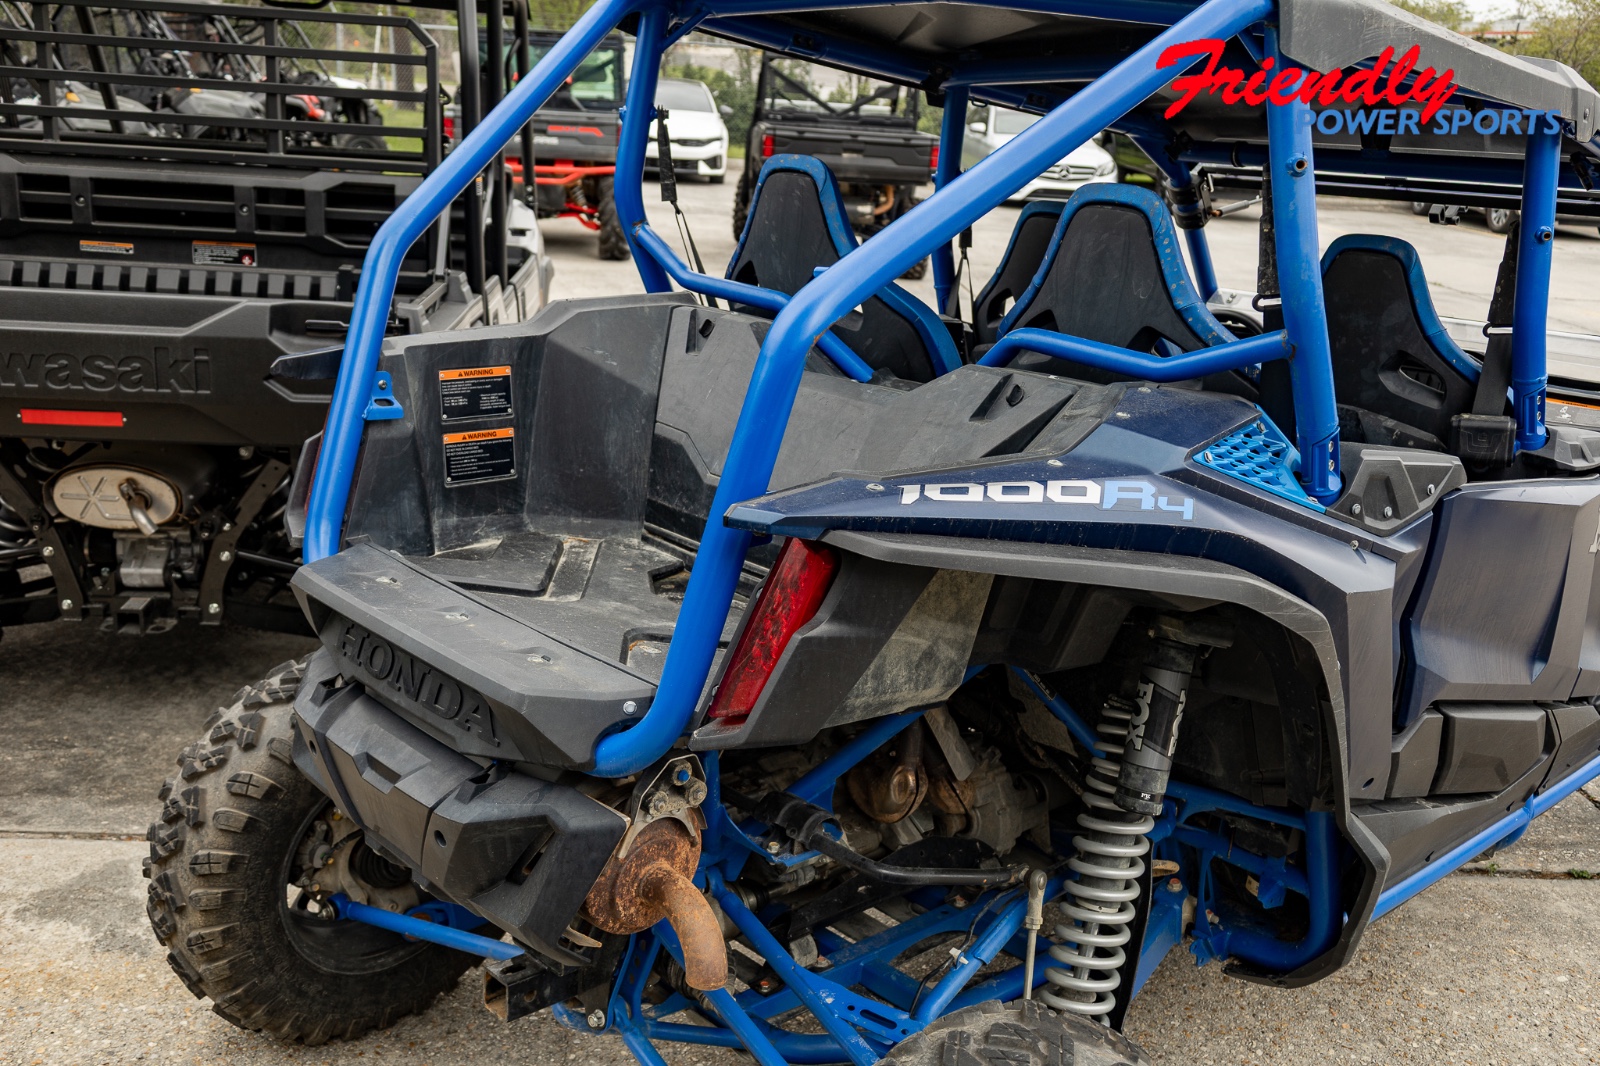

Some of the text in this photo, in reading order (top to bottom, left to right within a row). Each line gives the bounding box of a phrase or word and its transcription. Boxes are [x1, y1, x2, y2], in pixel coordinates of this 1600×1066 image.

[463, 369, 494, 377] WARNING
[467, 431, 498, 440] WARNING
[337, 622, 501, 748] HONDA
